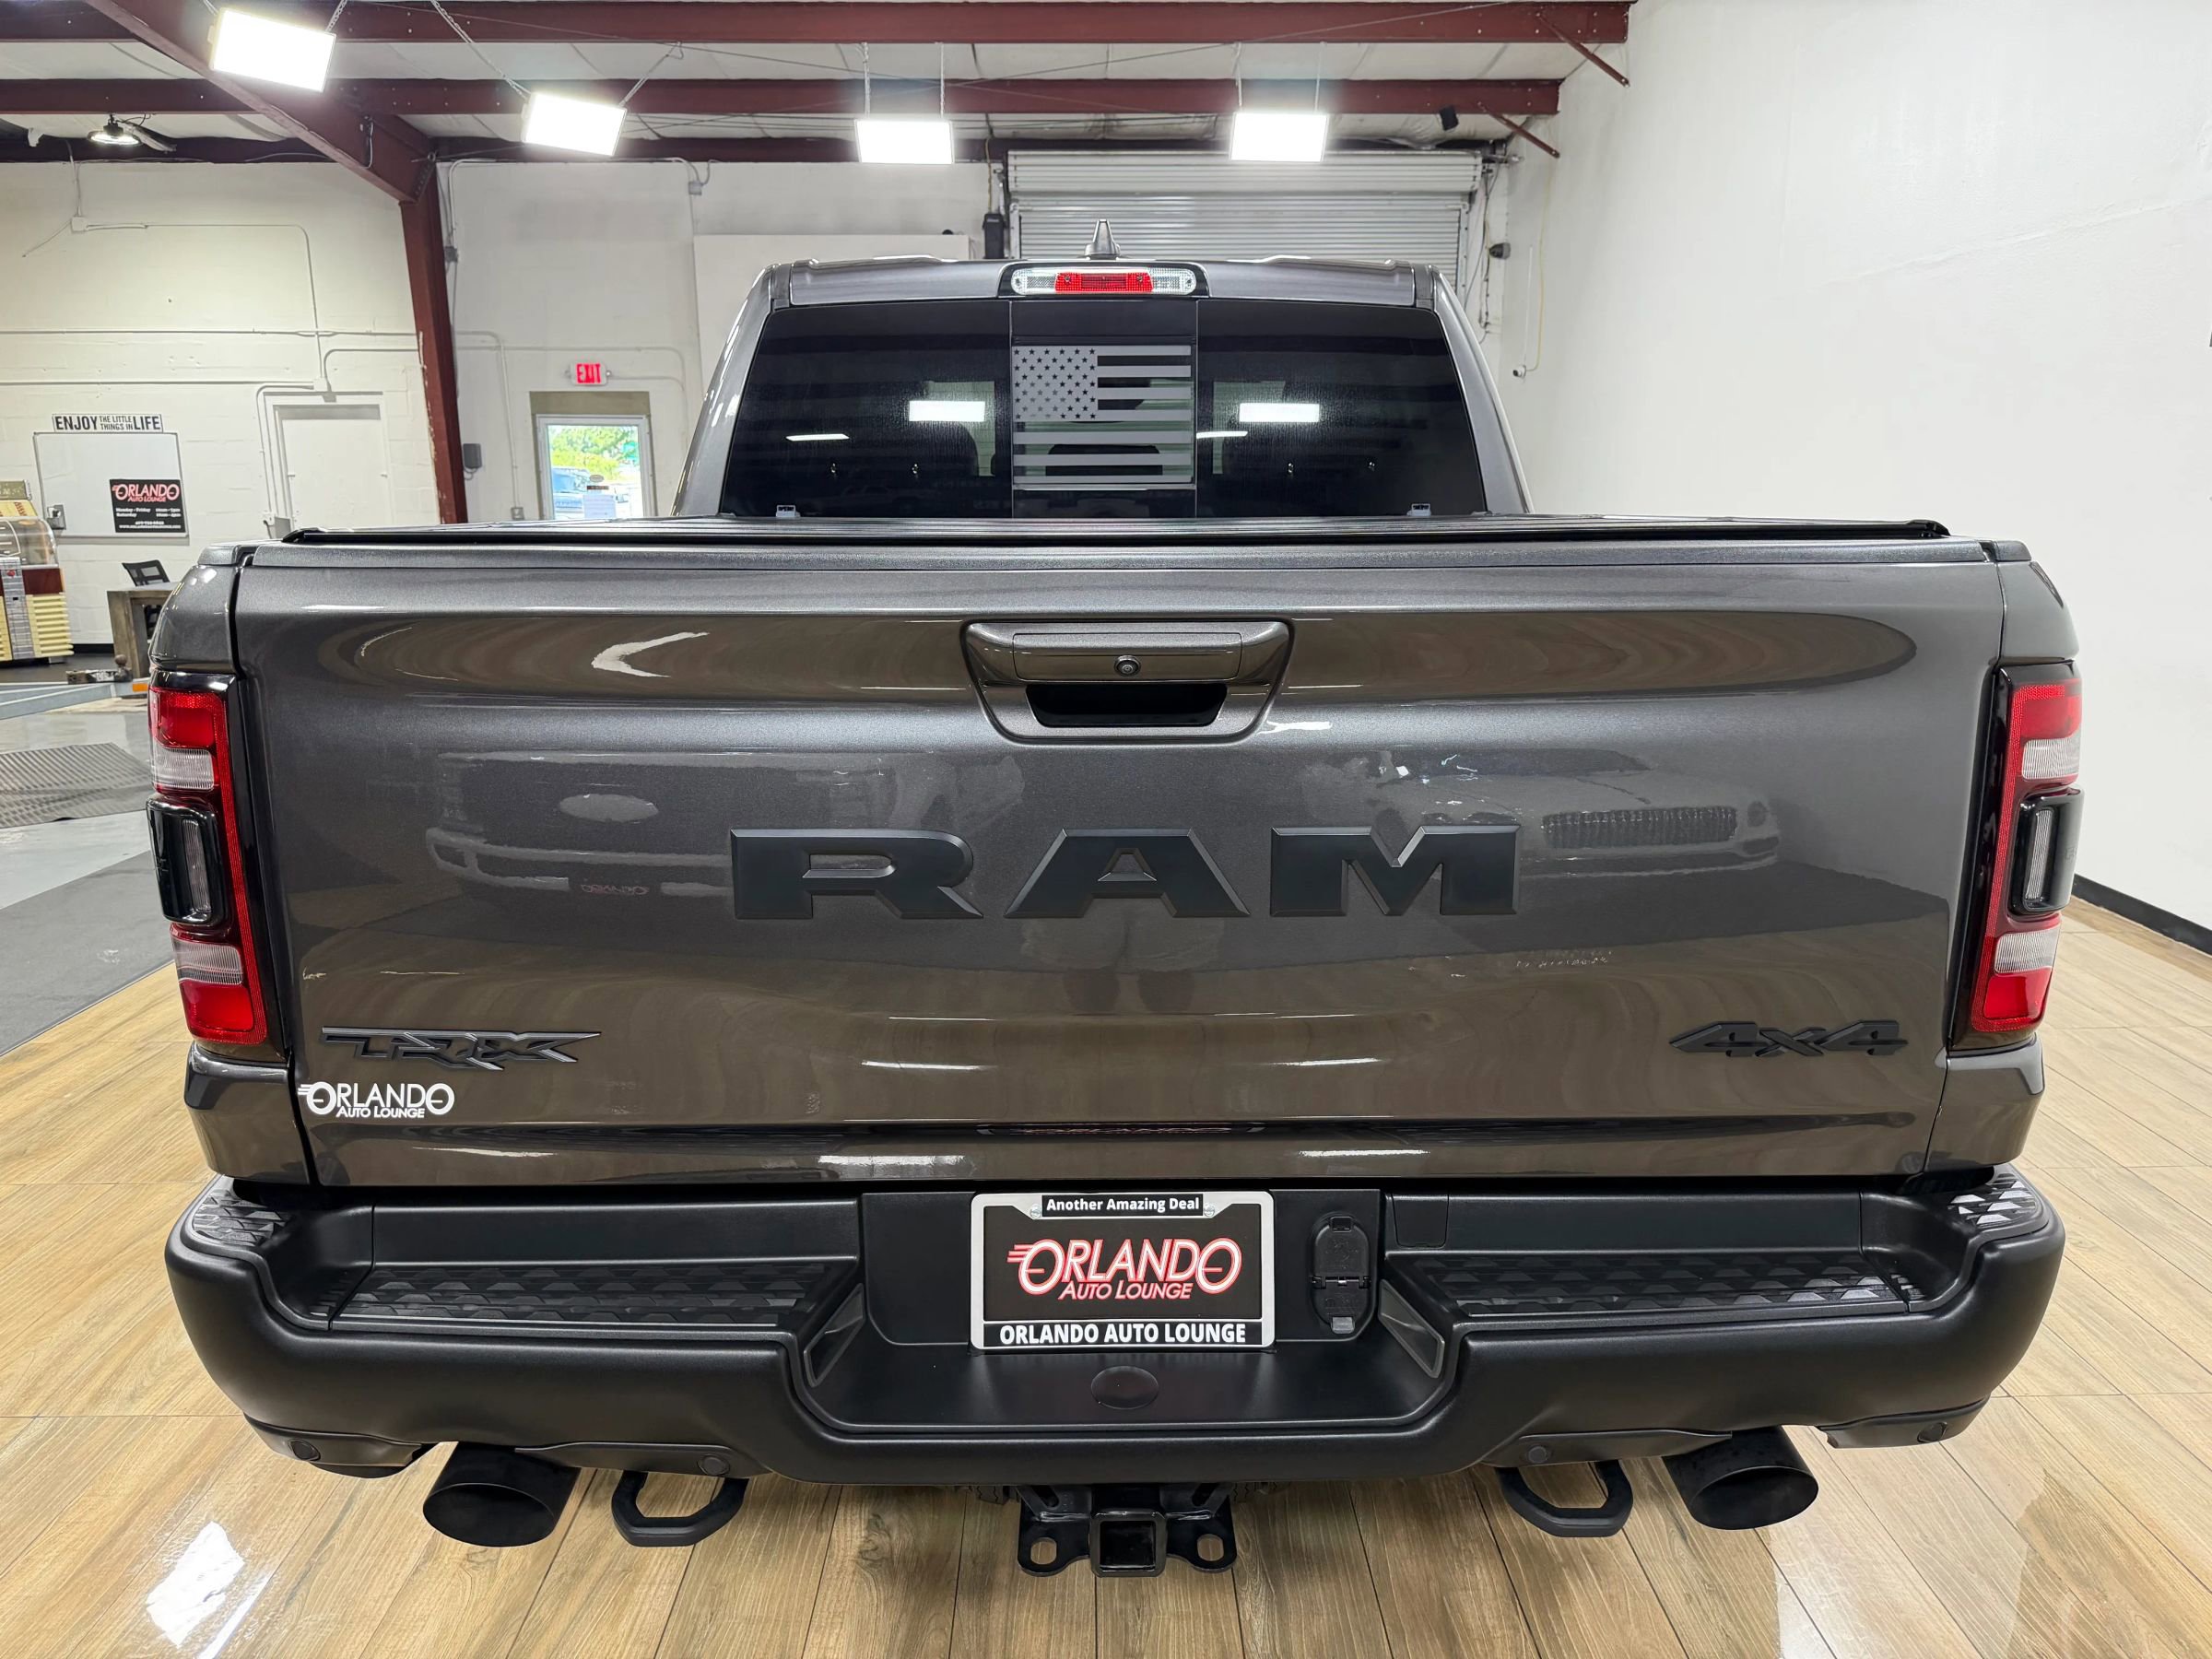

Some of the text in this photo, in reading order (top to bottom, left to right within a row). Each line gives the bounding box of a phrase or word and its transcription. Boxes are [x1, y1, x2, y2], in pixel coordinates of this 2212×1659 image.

[576, 363, 601, 384] EXIT
[55, 416, 98, 430] ENJOY
[133, 416, 160, 430] LIFE
[114, 484, 180, 500] ORLANDO
[730, 826, 1521, 921] RAM
[322, 1026, 602, 1071] TRX
[301, 1081, 455, 1115] ORLANDO
[336, 1106, 425, 1119] AUTO LOUNGE
[1046, 1197, 1199, 1214] Another Amazing Deal
[1012, 1237, 1242, 1295] ORLANDO
[1059, 1281, 1194, 1300] AUTO LOUNGE
[999, 1323, 1246, 1346] ORLANDO AUTO LOUNGE
